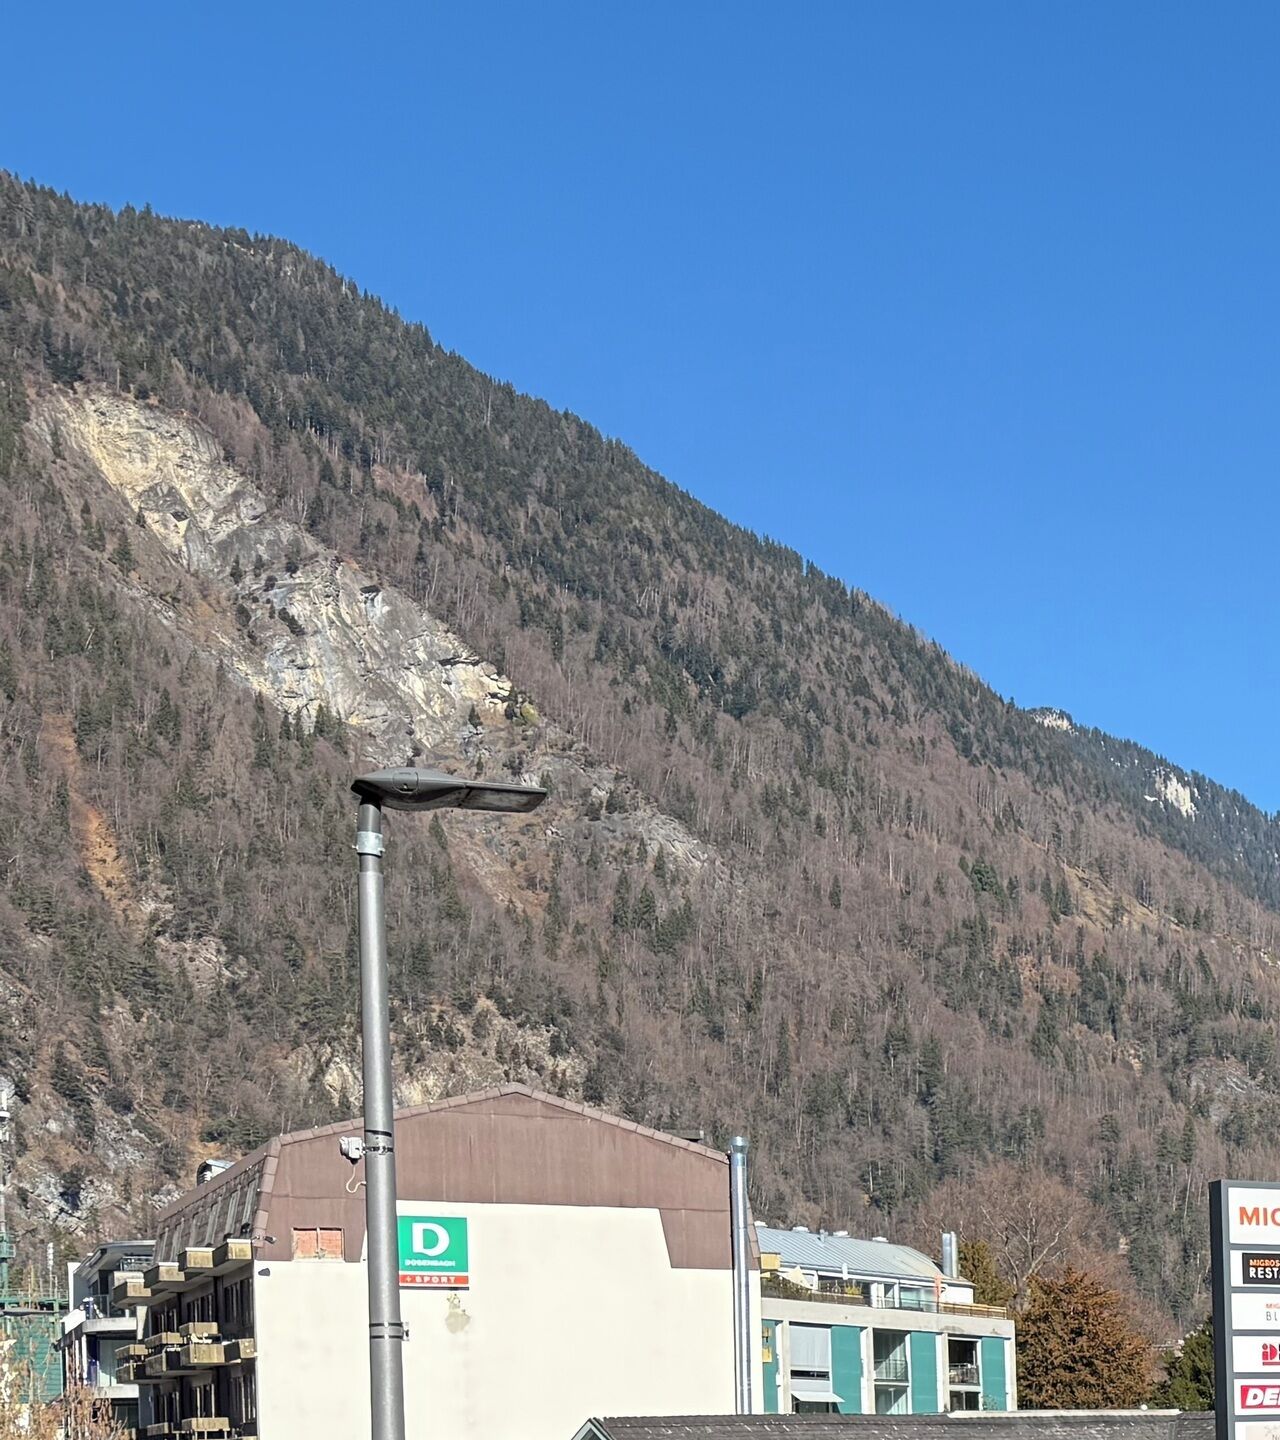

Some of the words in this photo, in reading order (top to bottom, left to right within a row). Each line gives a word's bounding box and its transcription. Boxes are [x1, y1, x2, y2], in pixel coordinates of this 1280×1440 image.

[412, 1222, 450, 1257] D
[1249, 1258, 1280, 1268] MIGROS
[415, 1276, 456, 1284] SPORT
